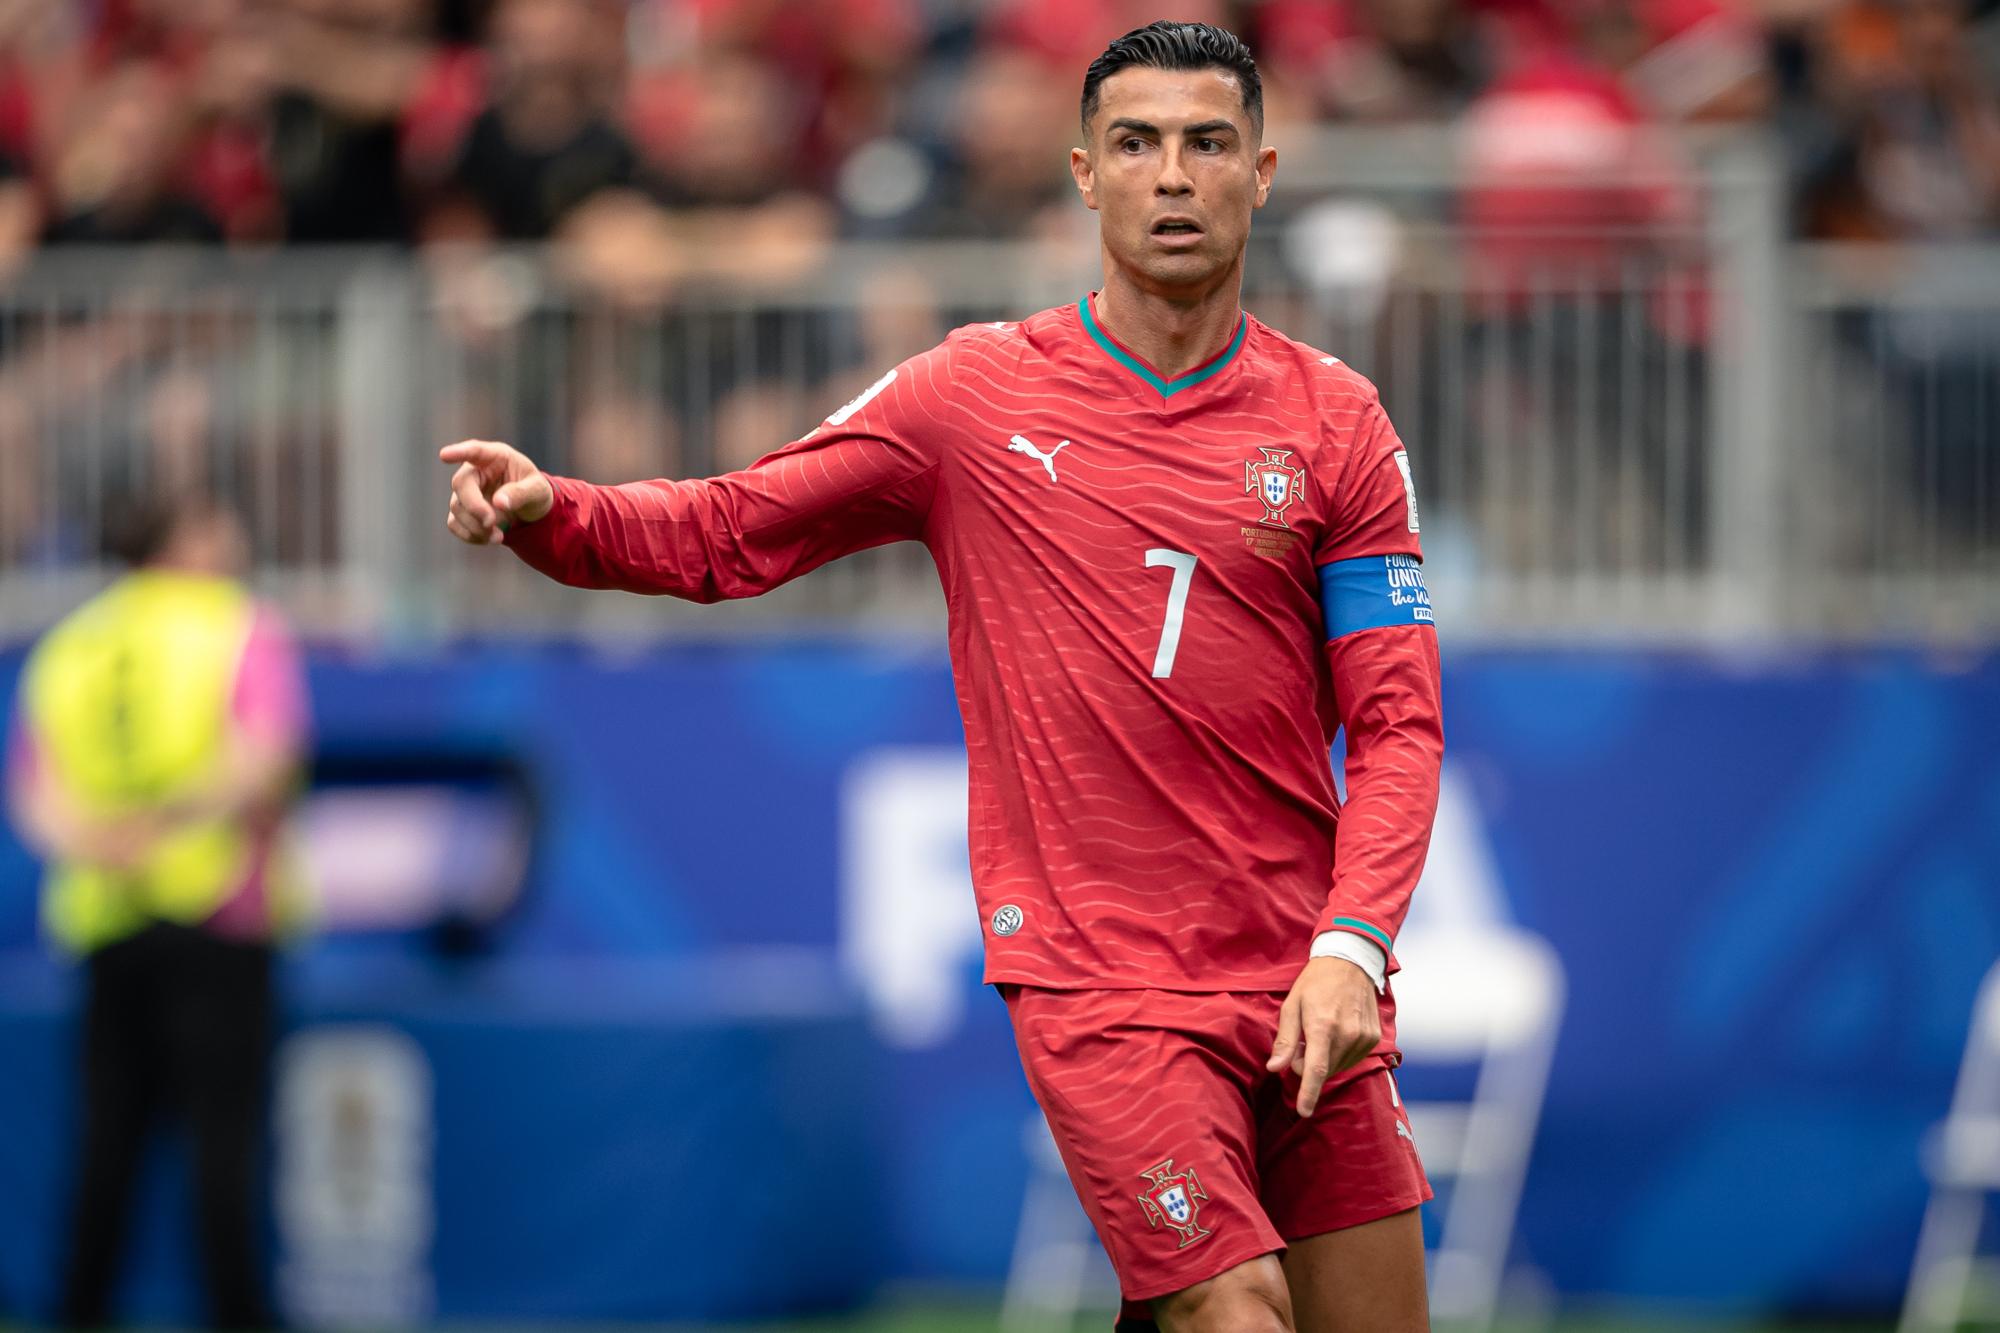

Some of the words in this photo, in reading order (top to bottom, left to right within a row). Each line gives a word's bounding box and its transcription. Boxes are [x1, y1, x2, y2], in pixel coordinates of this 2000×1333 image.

[1144, 547, 1199, 679] 7
[1387, 588, 1415, 606] the
[1413, 588, 1431, 605] W
